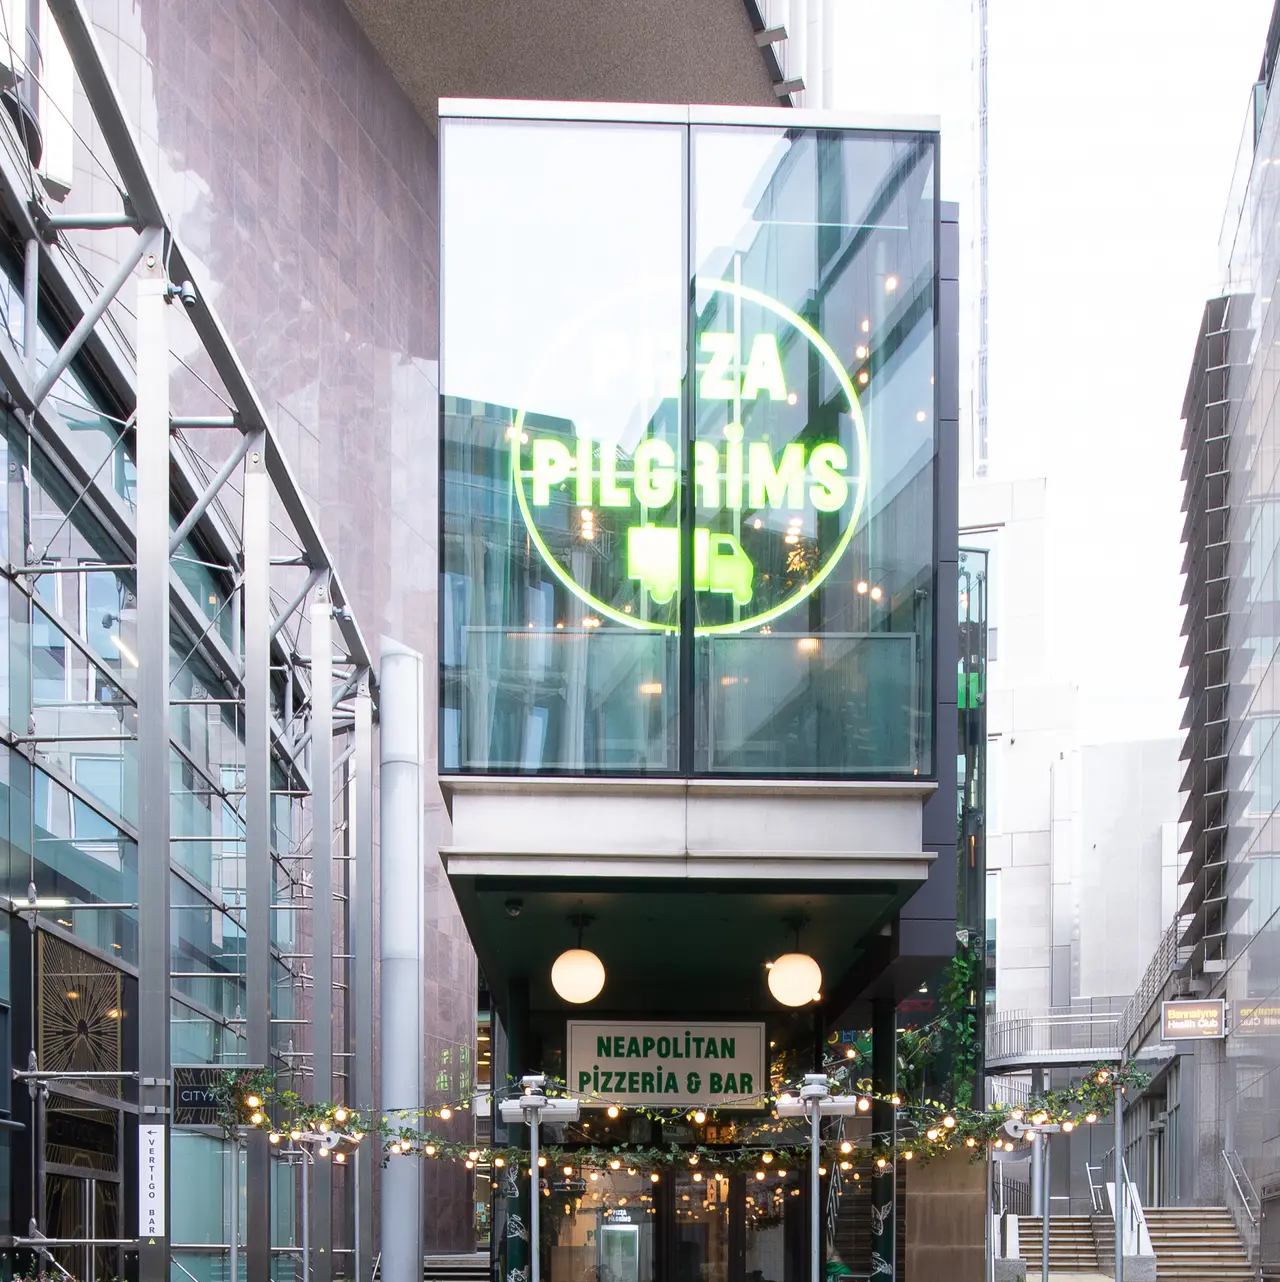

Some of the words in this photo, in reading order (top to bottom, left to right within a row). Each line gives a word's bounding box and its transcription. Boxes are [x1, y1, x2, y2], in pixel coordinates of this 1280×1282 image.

[1197, 1018, 1218, 1028] Club
[686, 1071, 702, 1095] &
[709, 1072, 753, 1095] BAR
[148, 1139, 156, 1199] VERTIGO
[148, 1209, 156, 1234] BAR
